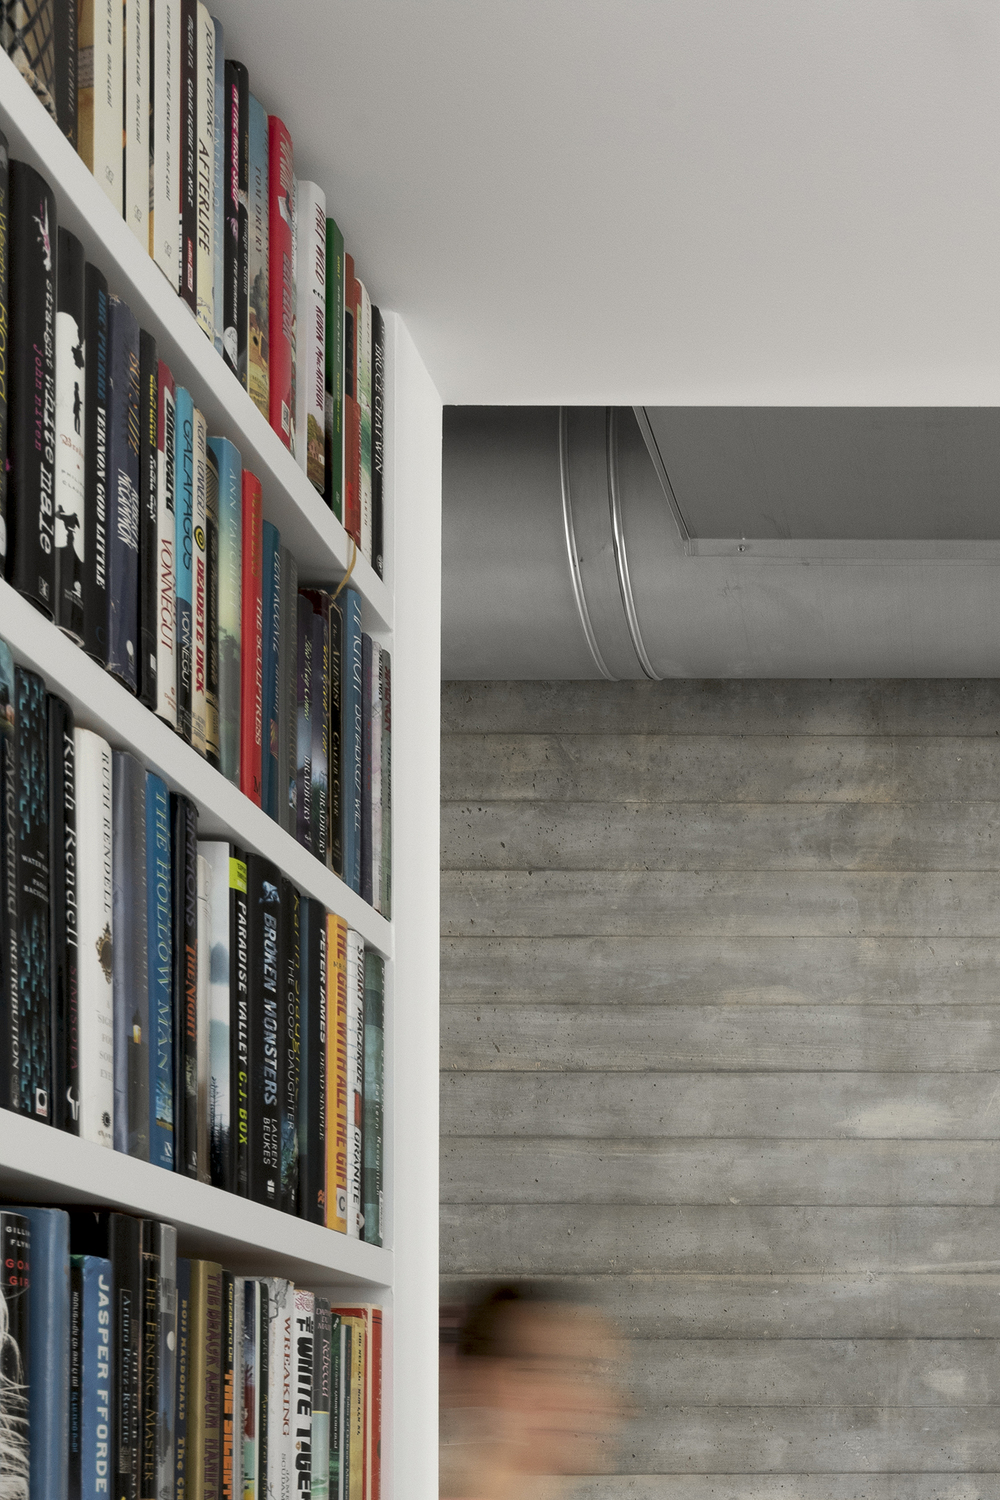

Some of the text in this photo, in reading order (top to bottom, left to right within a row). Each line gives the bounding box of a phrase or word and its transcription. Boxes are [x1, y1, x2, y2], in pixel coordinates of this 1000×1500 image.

[204, 23, 214, 138] JOHN UPDIKE
[198, 138, 210, 255] AFTERLIFE
[254, 166, 262, 255] TOM DRURY
[315, 203, 326, 284] HALF WILD
[281, 250, 293, 340] BEN ELTON
[32, 343, 43, 450] john niven
[315, 306, 324, 410] ROBIN MacARTHUR
[374, 341, 383, 473] BRUCE CHATWIN
[39, 279, 55, 555] straight white male
[96, 290, 106, 589] DBC PIERRE VERNON GOD LITTLE
[196, 420, 205, 522] KURT VONNEGUT
[182, 419, 194, 571] GALAPAGOS
[161, 538, 173, 655] VONNEGUT
[182, 610, 192, 692] VONNEGUT
[196, 556, 205, 696] DEADEYE DICK
[303, 755, 311, 823] BRADBURY
[332, 731, 340, 818] CALEB CARR
[63, 731, 78, 948] Ruth Rendell
[101, 751, 112, 914] RUTH RENDELL
[186, 807, 197, 927] SIMMONS
[156, 790, 169, 1073] THE HOLLOW MAN
[318, 929, 326, 1043] PETER JAMES
[237, 901, 247, 1147] PARADISE VALLEY C.J. BOX
[264, 912, 278, 1105] BROKEN MONSTERS
[288, 958, 296, 1130] THE GOOD DAUGHTER
[263, 1117, 271, 1165] BEUKES
[270, 1118, 278, 1169] LAUREN
[353, 1131, 361, 1204] GRANITE
[95, 1274, 109, 1380] JASPER
[144, 1278, 157, 1481] THE FENCING MASTER
[178, 1300, 187, 1420] ROSS MACDONALD
[282, 1317, 291, 1437] WREAKING
[297, 1338, 312, 1416] WHITE
[322, 1339, 330, 1397] Rebecca
[95, 1389, 109, 1494] FFORDE
[222, 1370, 233, 1414] THE
[175, 1436, 185, 1470] The
[222, 1420, 233, 1500] SILENT
